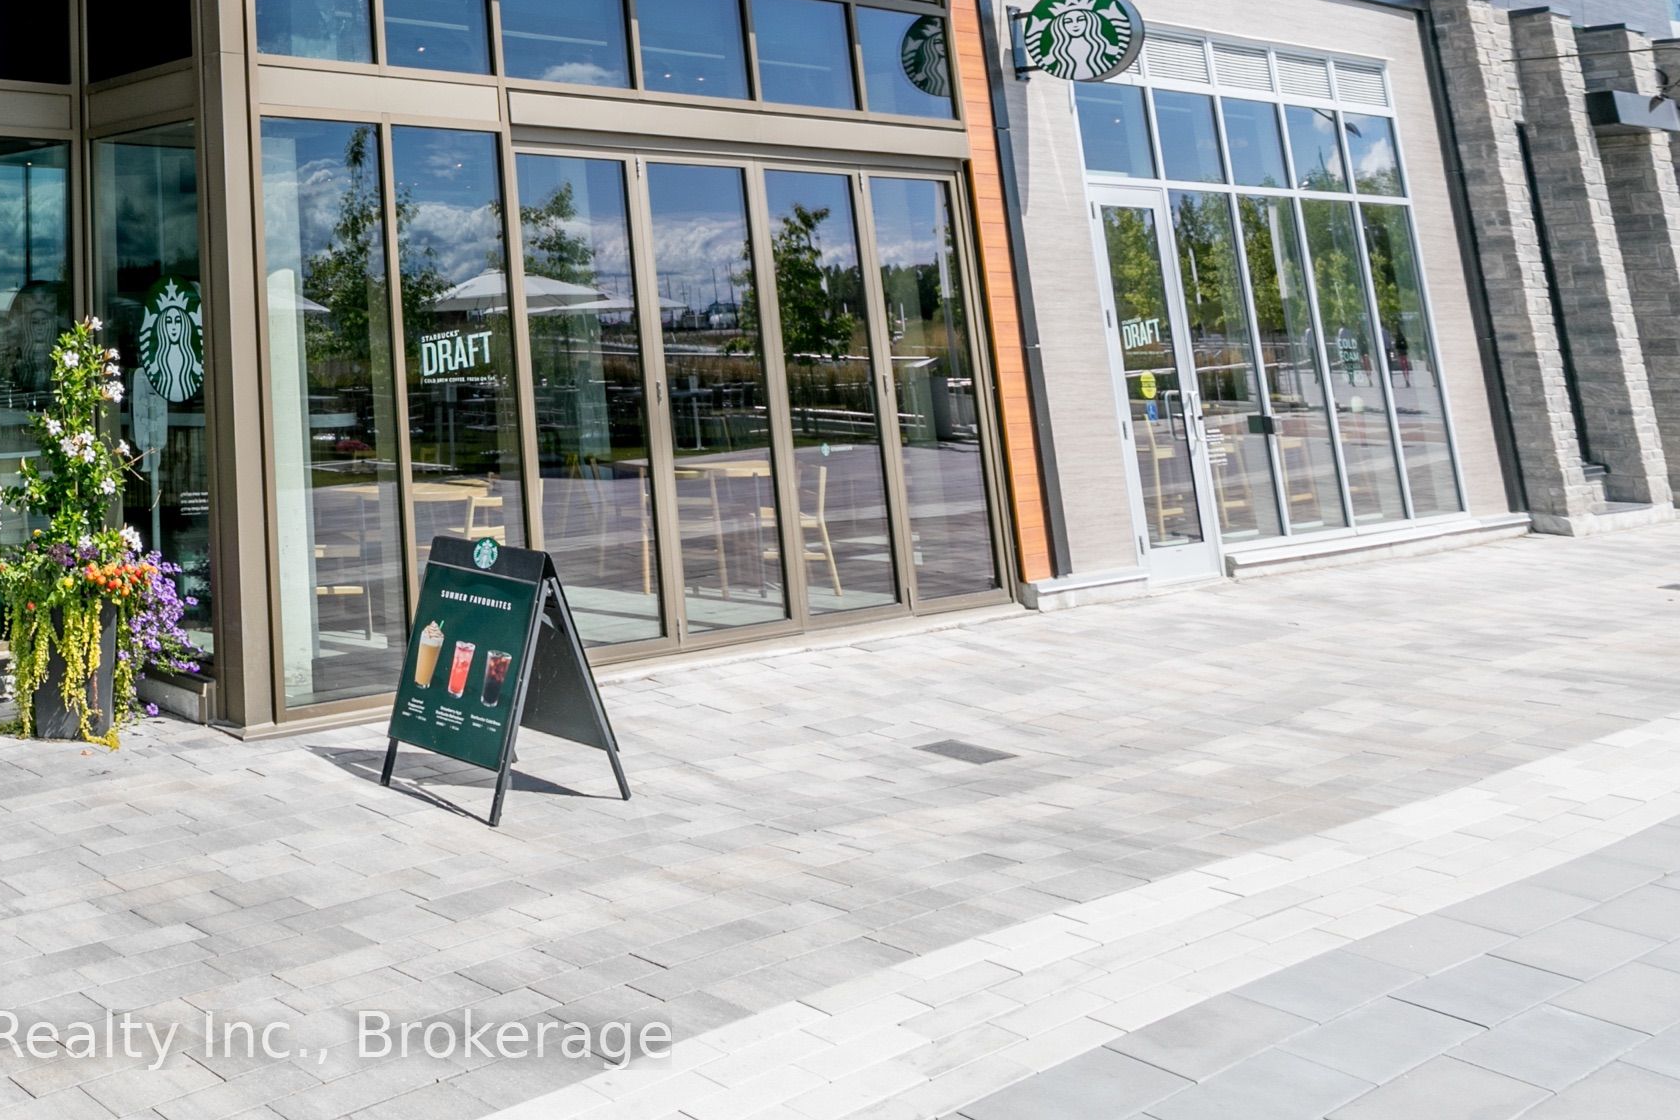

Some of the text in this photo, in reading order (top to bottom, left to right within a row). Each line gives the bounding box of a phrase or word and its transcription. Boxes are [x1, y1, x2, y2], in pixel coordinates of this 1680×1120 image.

[1122, 318, 1160, 350] DRAFT
[422, 331, 493, 376] DRAFT
[440, 589, 512, 611] SUMMER FAVOURITES
